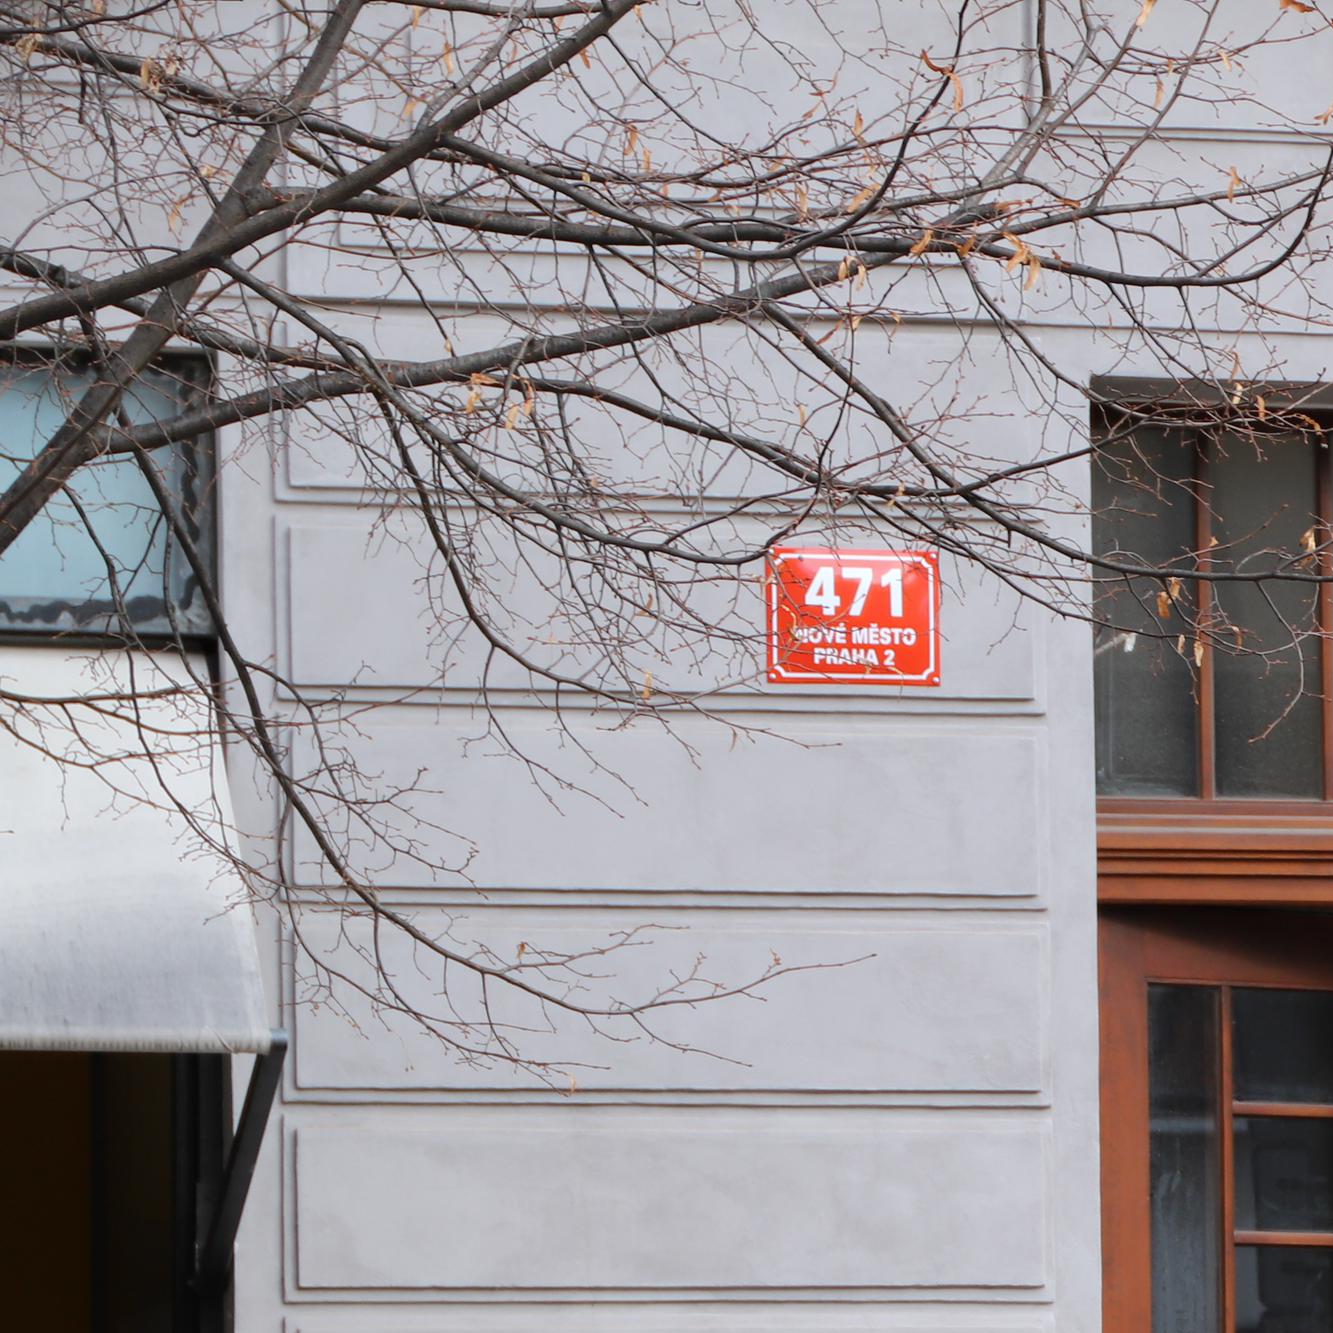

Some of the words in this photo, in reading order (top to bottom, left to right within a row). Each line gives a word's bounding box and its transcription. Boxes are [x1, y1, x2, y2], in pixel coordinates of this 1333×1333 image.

[805, 567, 903, 617] 471
[795, 622, 847, 645] NOVÉ
[852, 624, 916, 646] MĚSTO
[813, 648, 879, 666] PRAHA
[884, 650, 896, 666] 2
